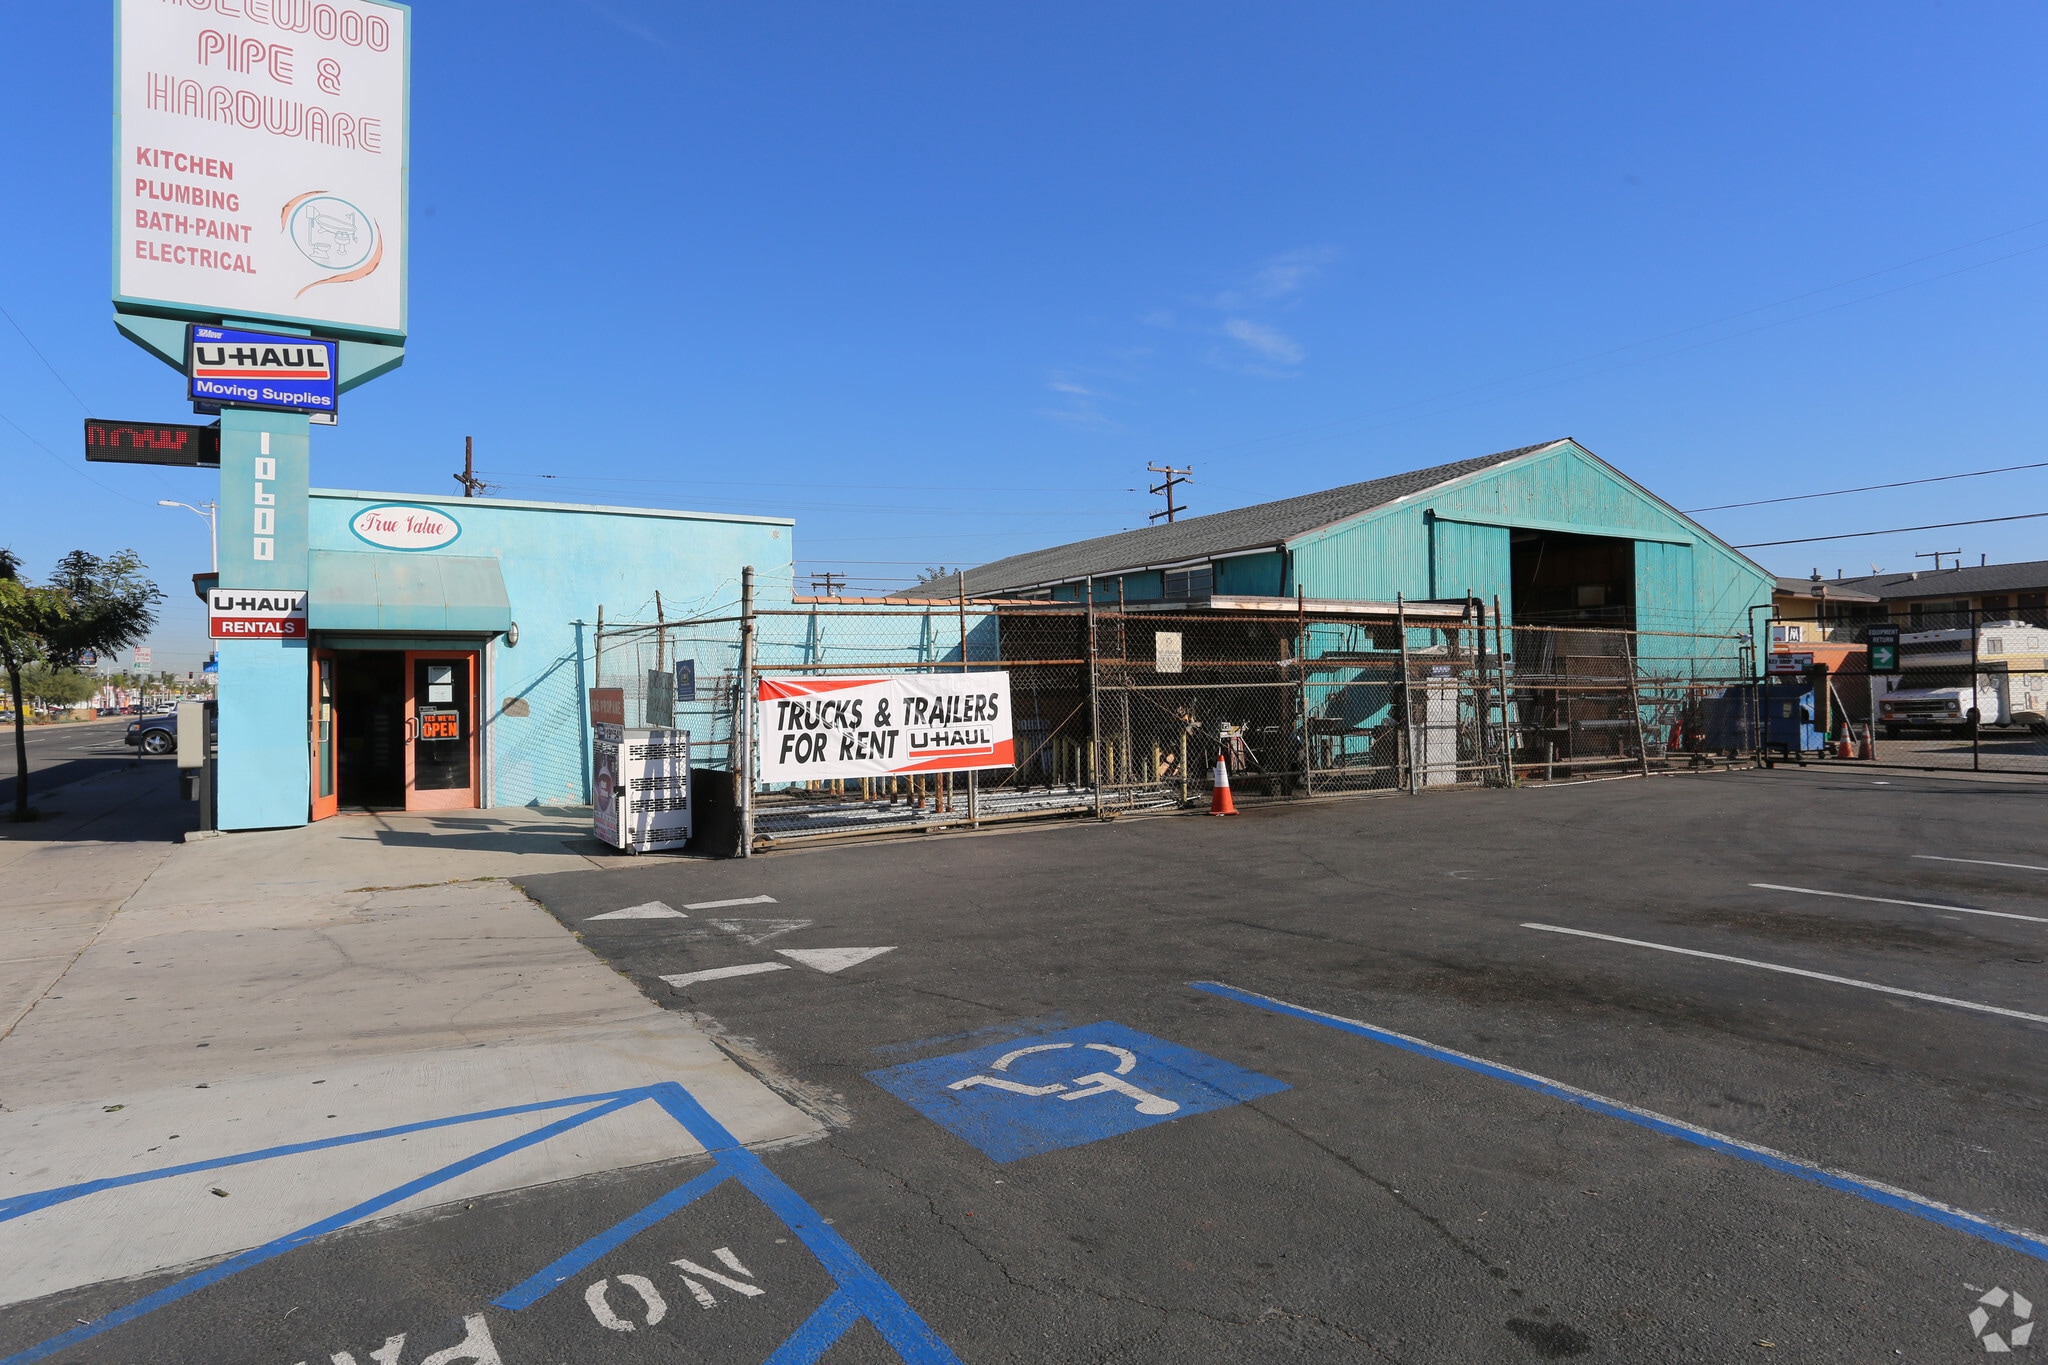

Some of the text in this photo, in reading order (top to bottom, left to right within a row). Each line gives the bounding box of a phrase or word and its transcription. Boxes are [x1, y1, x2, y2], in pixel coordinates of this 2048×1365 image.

[161, 0, 389, 53] LEWOOD
[198, 29, 342, 97] PIPE &
[147, 71, 382, 154] HARDWARE
[136, 146, 234, 181] KITCHEN
[135, 177, 240, 213] PLUMBING
[135, 208, 252, 244] BATH-PAINT
[135, 239, 257, 275] ELECTRICAL
[196, 346, 325, 368] U-HAUL
[196, 380, 332, 406] Moving Supplies
[253, 431, 276, 561] 10600
[360, 512, 448, 536] True Value
[213, 596, 303, 612] U-HAUL
[221, 621, 295, 634] RENTALS
[1868, 628, 1899, 636] EQUIPMENT
[777, 692, 999, 732] TRUCKS & TRAILERS
[423, 722, 457, 738] OPEN
[779, 728, 899, 765] FOR RENT
[910, 728, 991, 750] U-HAUL
